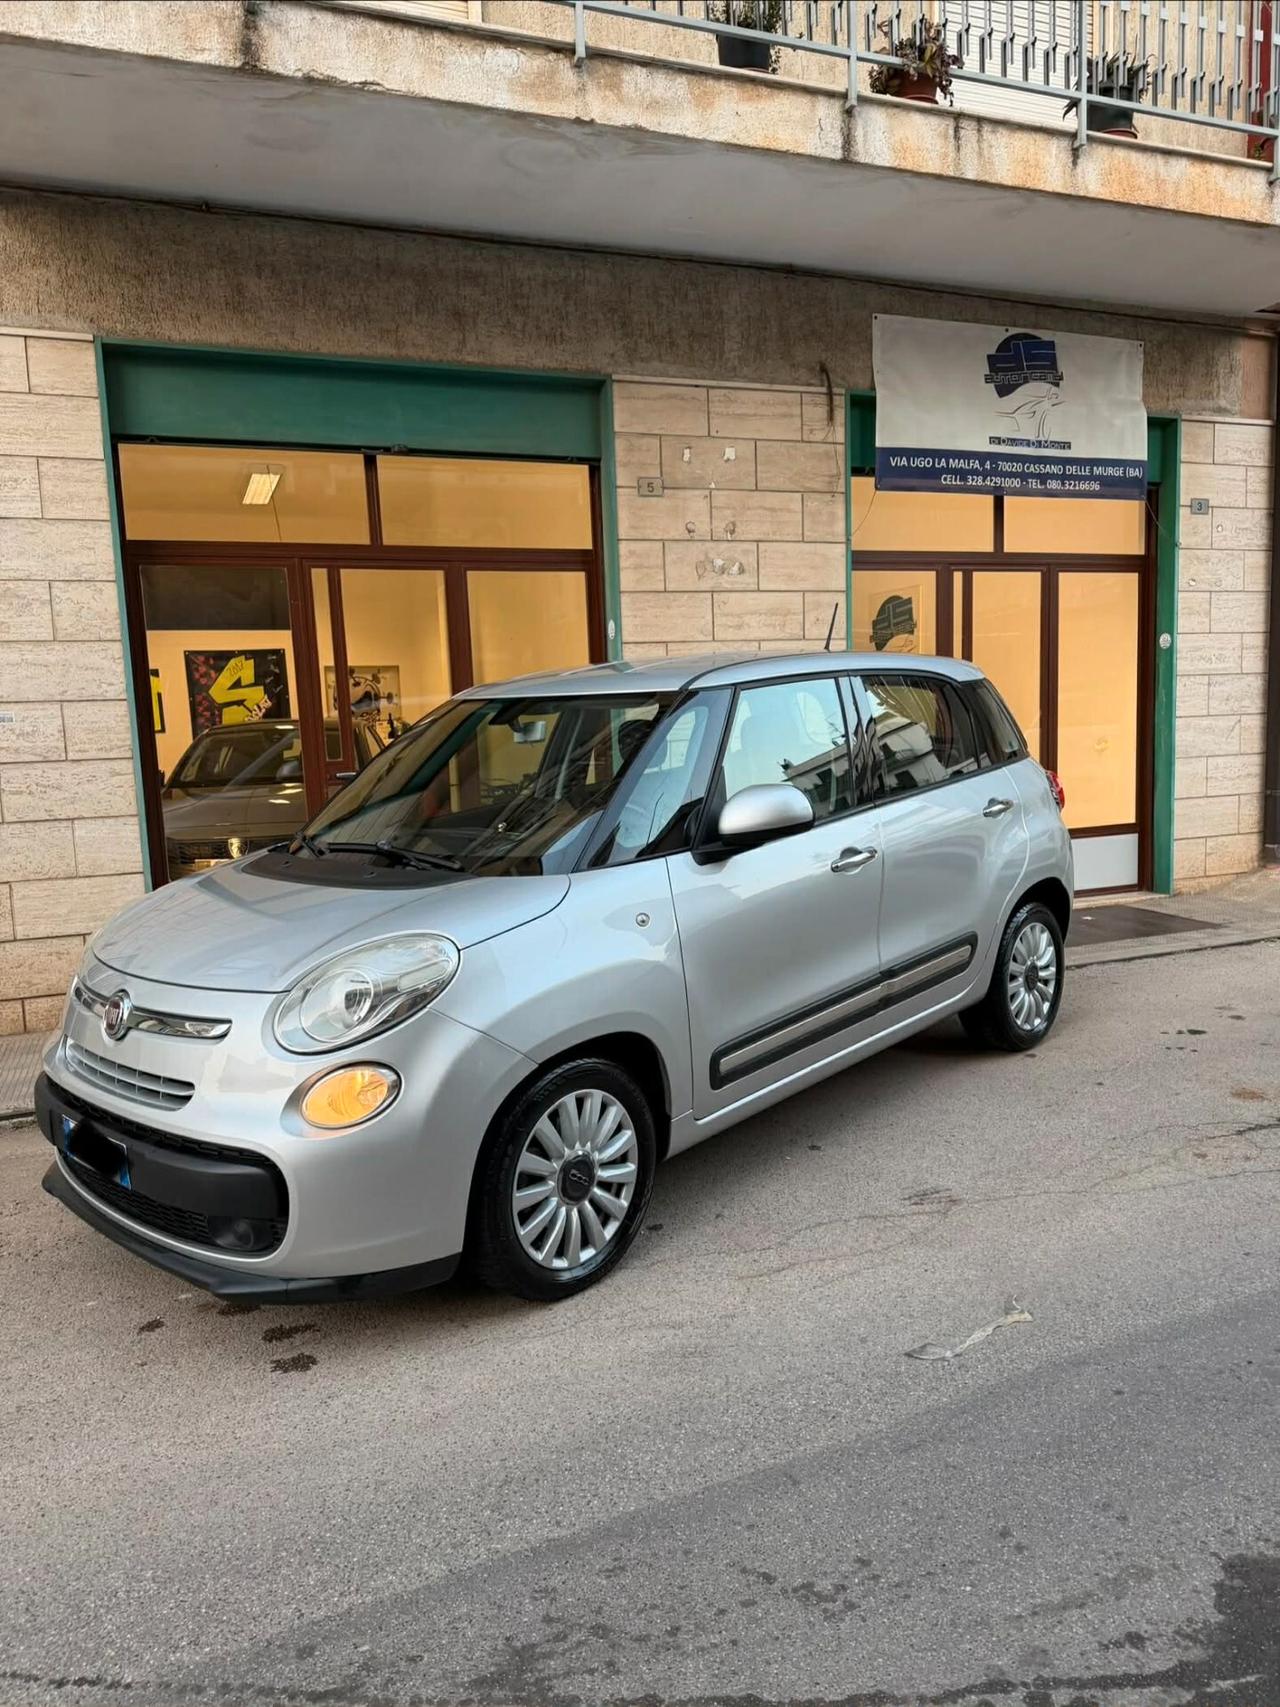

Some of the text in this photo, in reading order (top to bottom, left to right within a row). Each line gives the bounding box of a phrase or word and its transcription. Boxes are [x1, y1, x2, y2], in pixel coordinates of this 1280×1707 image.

[889, 456, 908, 467] VIA
[910, 457, 933, 468] UGO
[935, 458, 947, 468] LA
[948, 458, 983, 471] MALFA,
[984, 460, 991, 470] 4
[997, 461, 1023, 472] 70020
[1024, 463, 1063, 475] CASSANO
[1065, 465, 1091, 476] DELLE
[1093, 466, 1124, 477] MURGE
[1125, 466, 1143, 479] (BA)
[647, 482, 655, 493] 5
[941, 474, 964, 485] CELL.
[966, 475, 1021, 487] 328.4291000
[1027, 478, 1045, 489] TEL.
[1046, 480, 1100, 490] 080.3216696
[1196, 501, 1203, 511] 3
